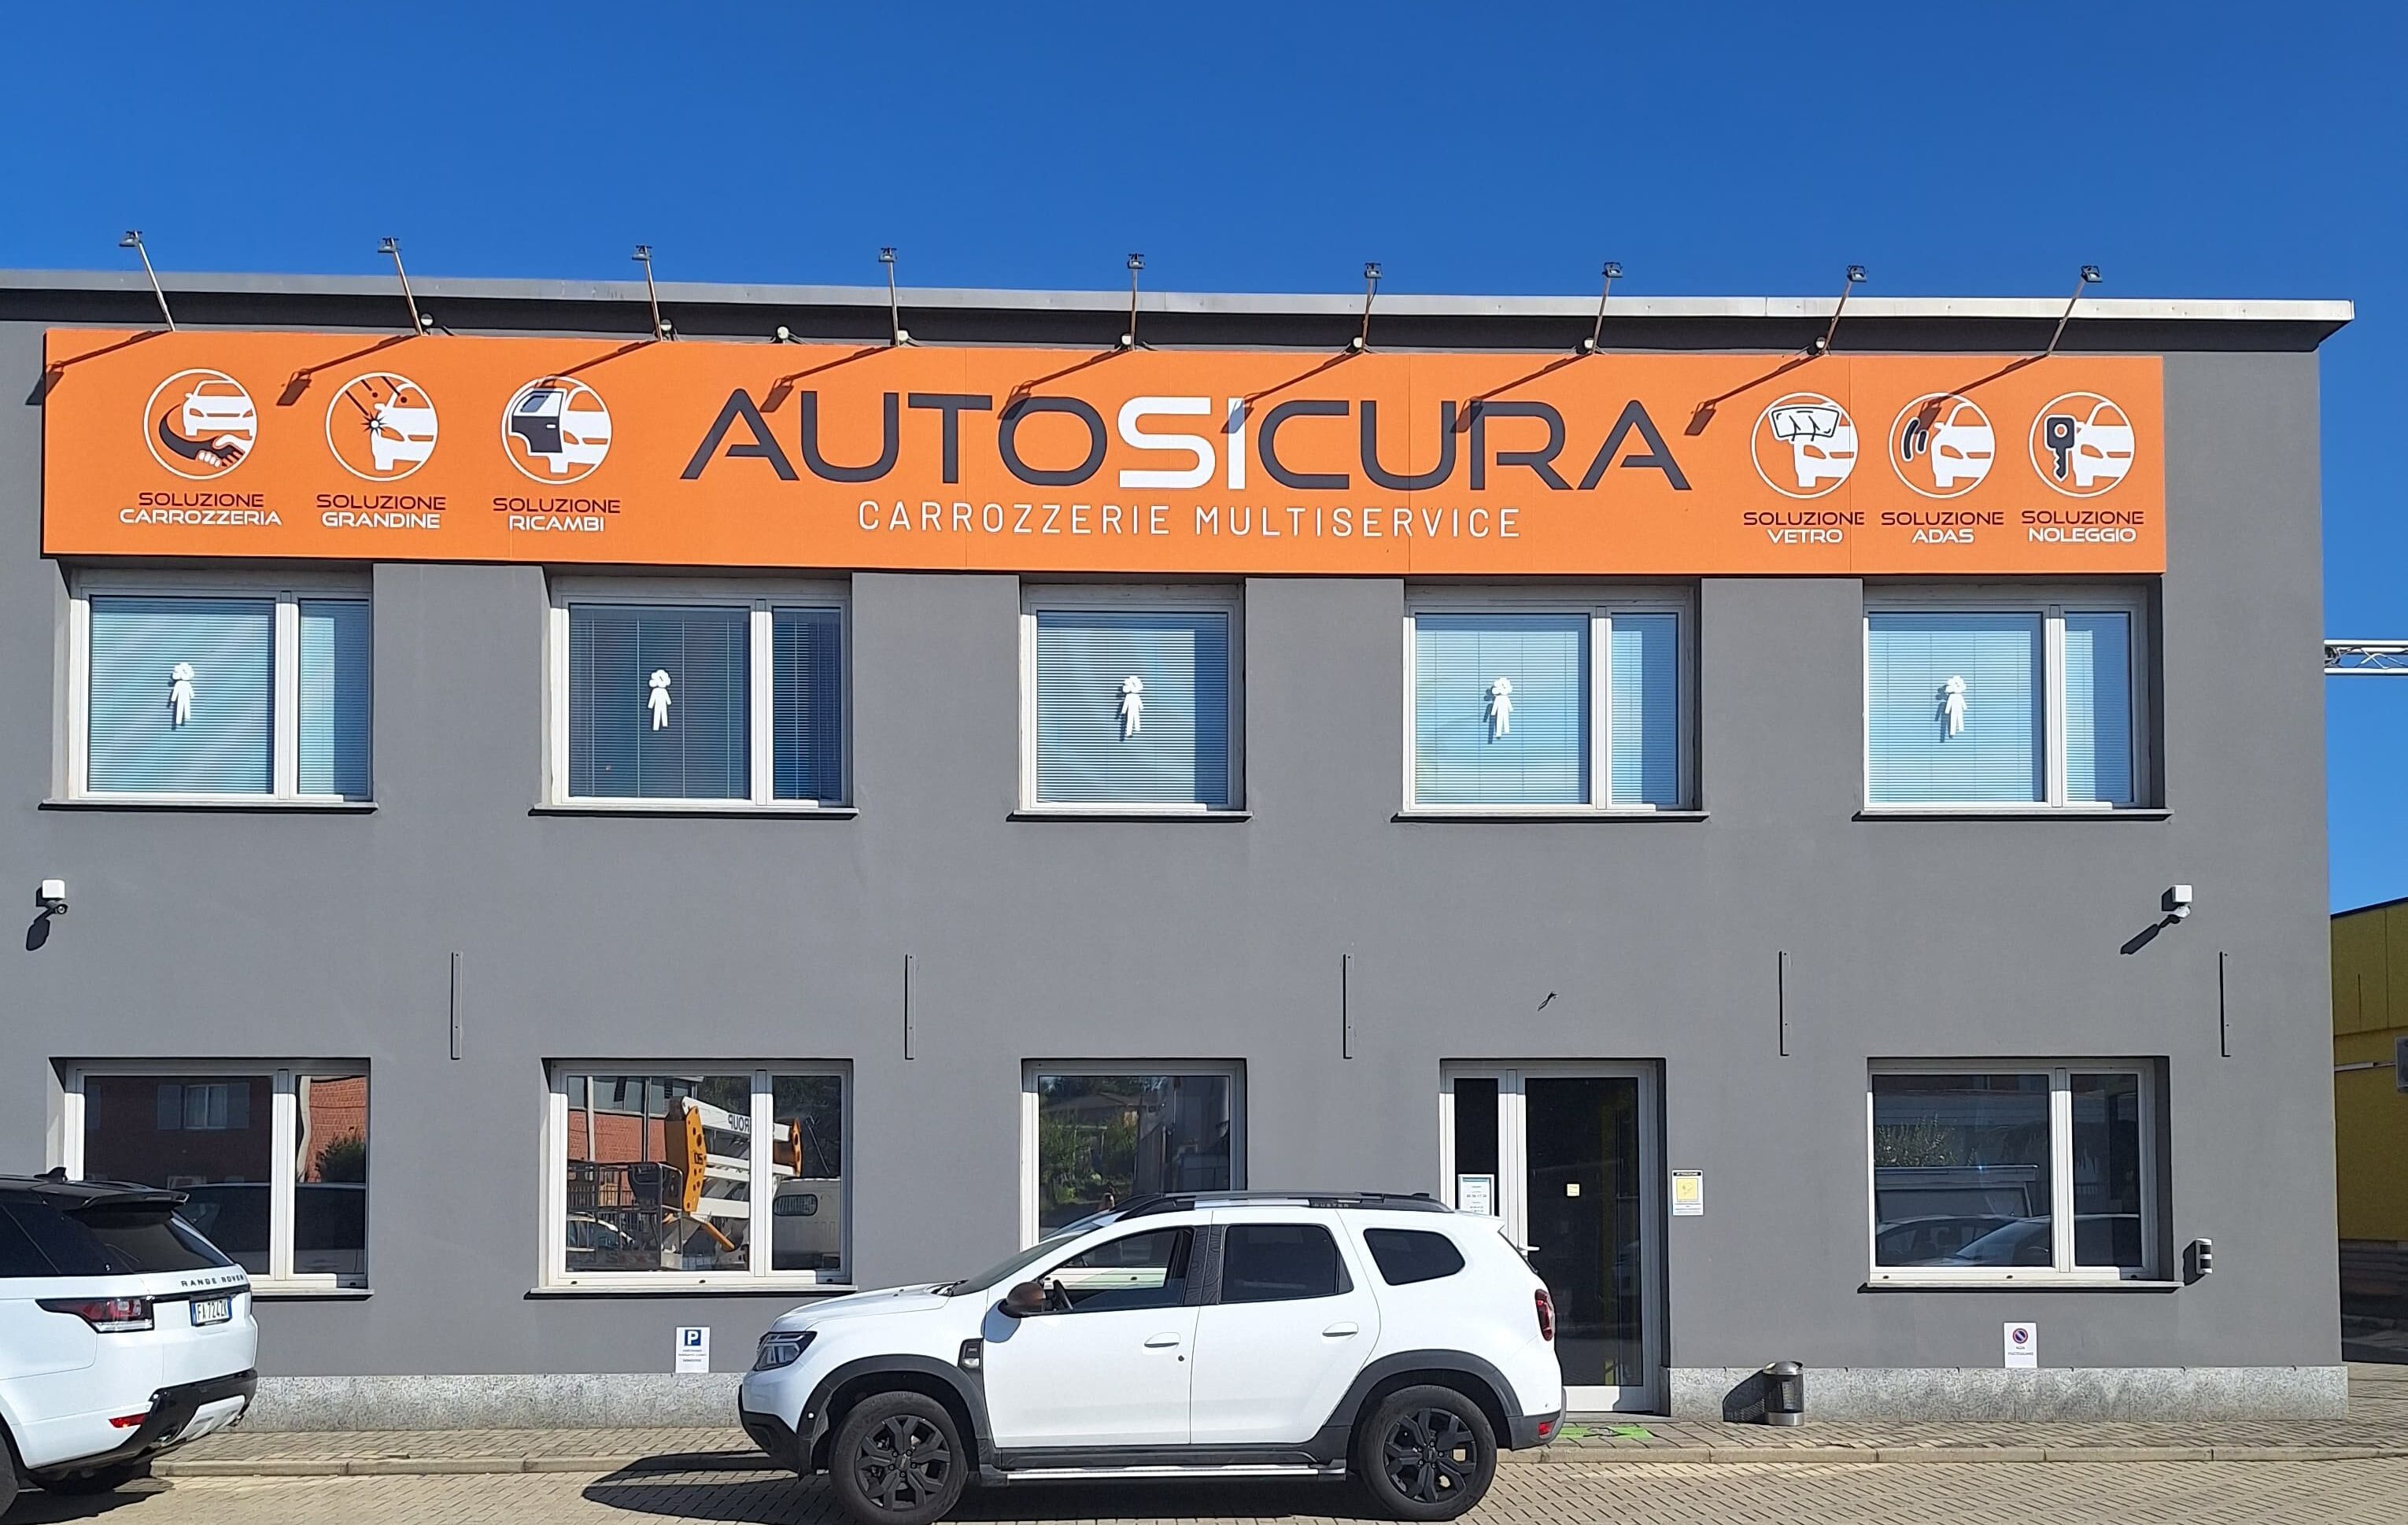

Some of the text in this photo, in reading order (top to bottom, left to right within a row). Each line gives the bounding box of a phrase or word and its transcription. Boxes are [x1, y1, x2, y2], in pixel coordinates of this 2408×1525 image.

[681, 388, 1691, 492] AUTOSICURA
[138, 492, 264, 508] SOLUZIONE
[316, 493, 446, 511] SOLUZIONE
[493, 497, 621, 514] SOLUZIONE
[120, 508, 282, 526] CARROZZERIA
[322, 511, 440, 529] GRANDINE
[509, 515, 604, 532] RICAMBI
[859, 500, 1520, 538] CARROZZERIE MULTISERVICE
[1743, 511, 1865, 526] SOLUZIONE
[1881, 511, 2004, 526] SOLUZIONE
[2021, 510, 2144, 525] SOLUZIONE
[1767, 528, 1843, 544] VETRO
[1911, 528, 1974, 544] ADAS
[2028, 527, 2137, 543] NOLEGGIO
[181, 1278, 217, 1287] RANGE
[687, 1331, 699, 1345] P
